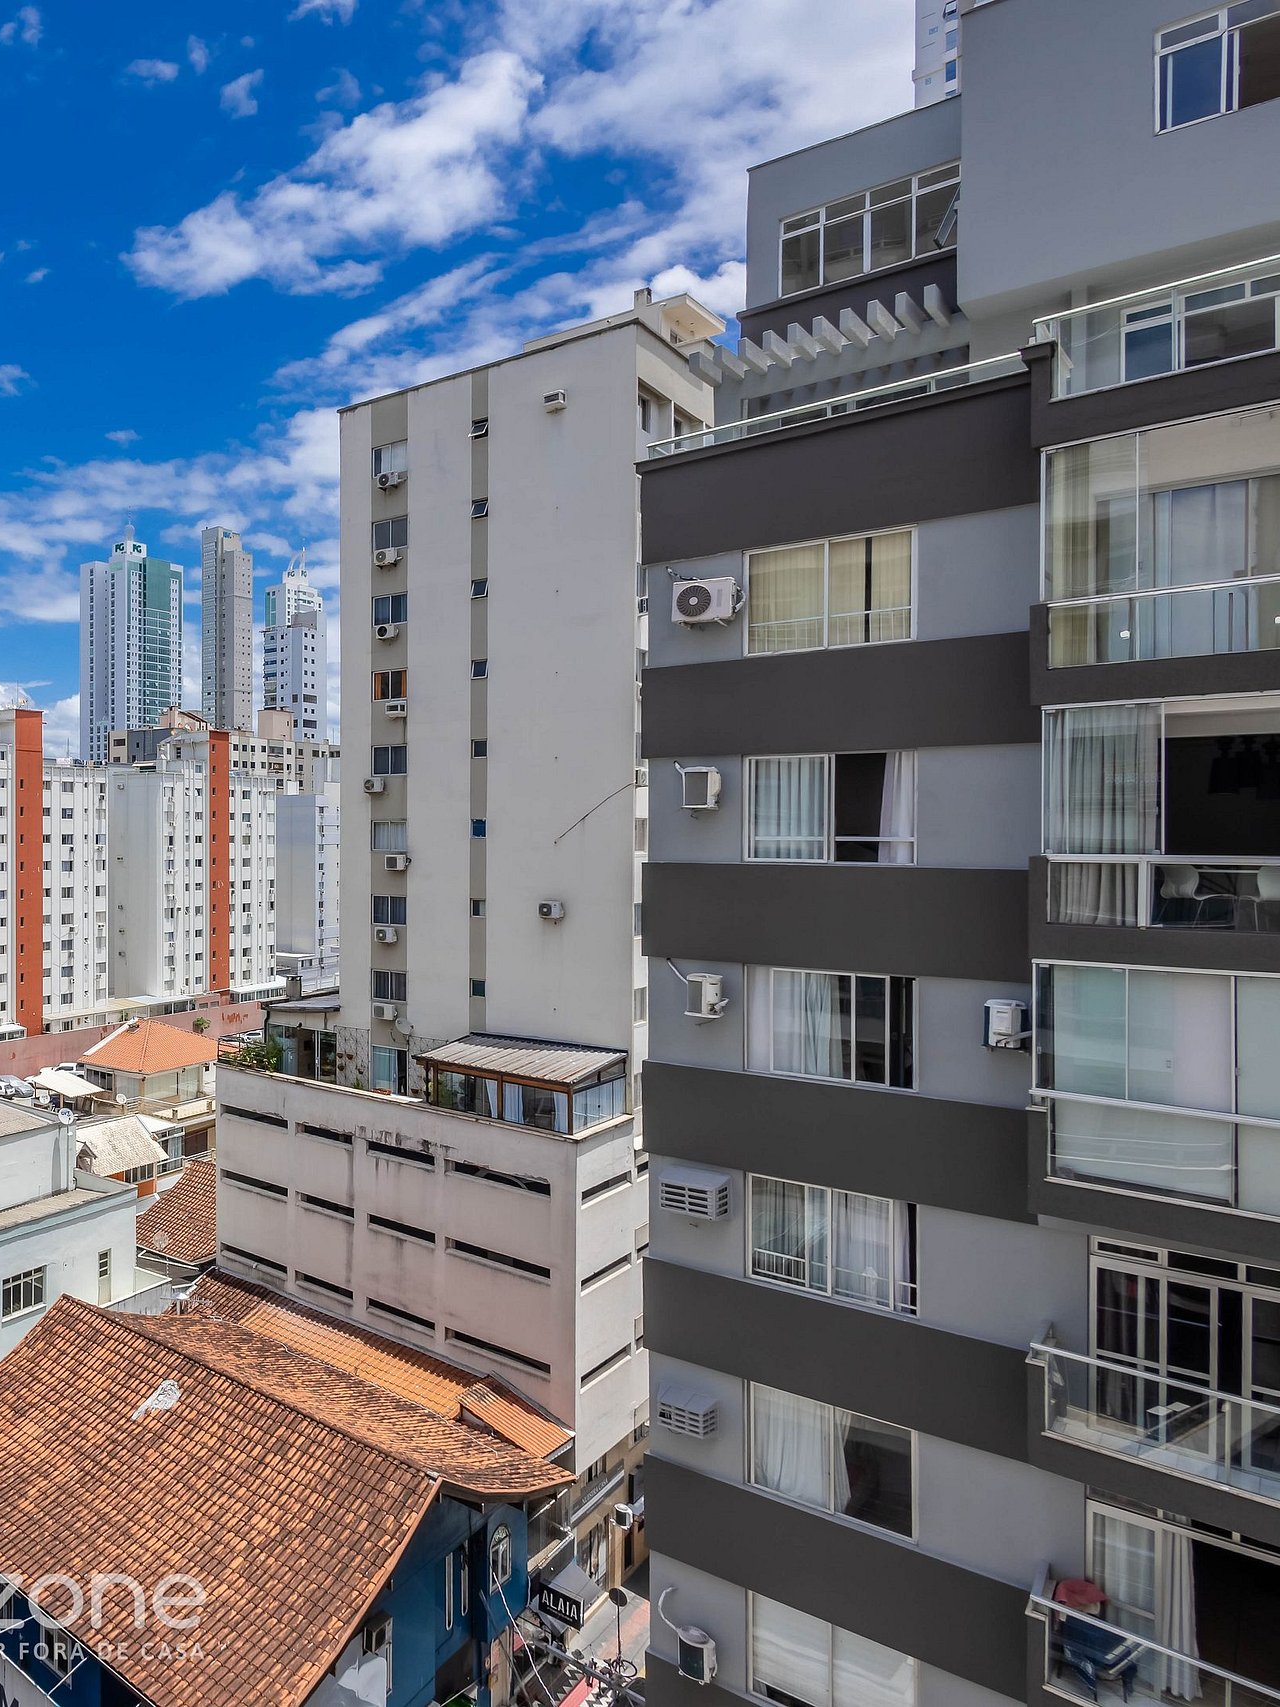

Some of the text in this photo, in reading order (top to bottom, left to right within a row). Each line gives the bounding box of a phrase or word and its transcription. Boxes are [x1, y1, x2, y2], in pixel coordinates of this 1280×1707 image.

[114, 543, 124, 552] FG
[132, 543, 142, 553] FG
[542, 1590, 577, 1620] ALAIA
